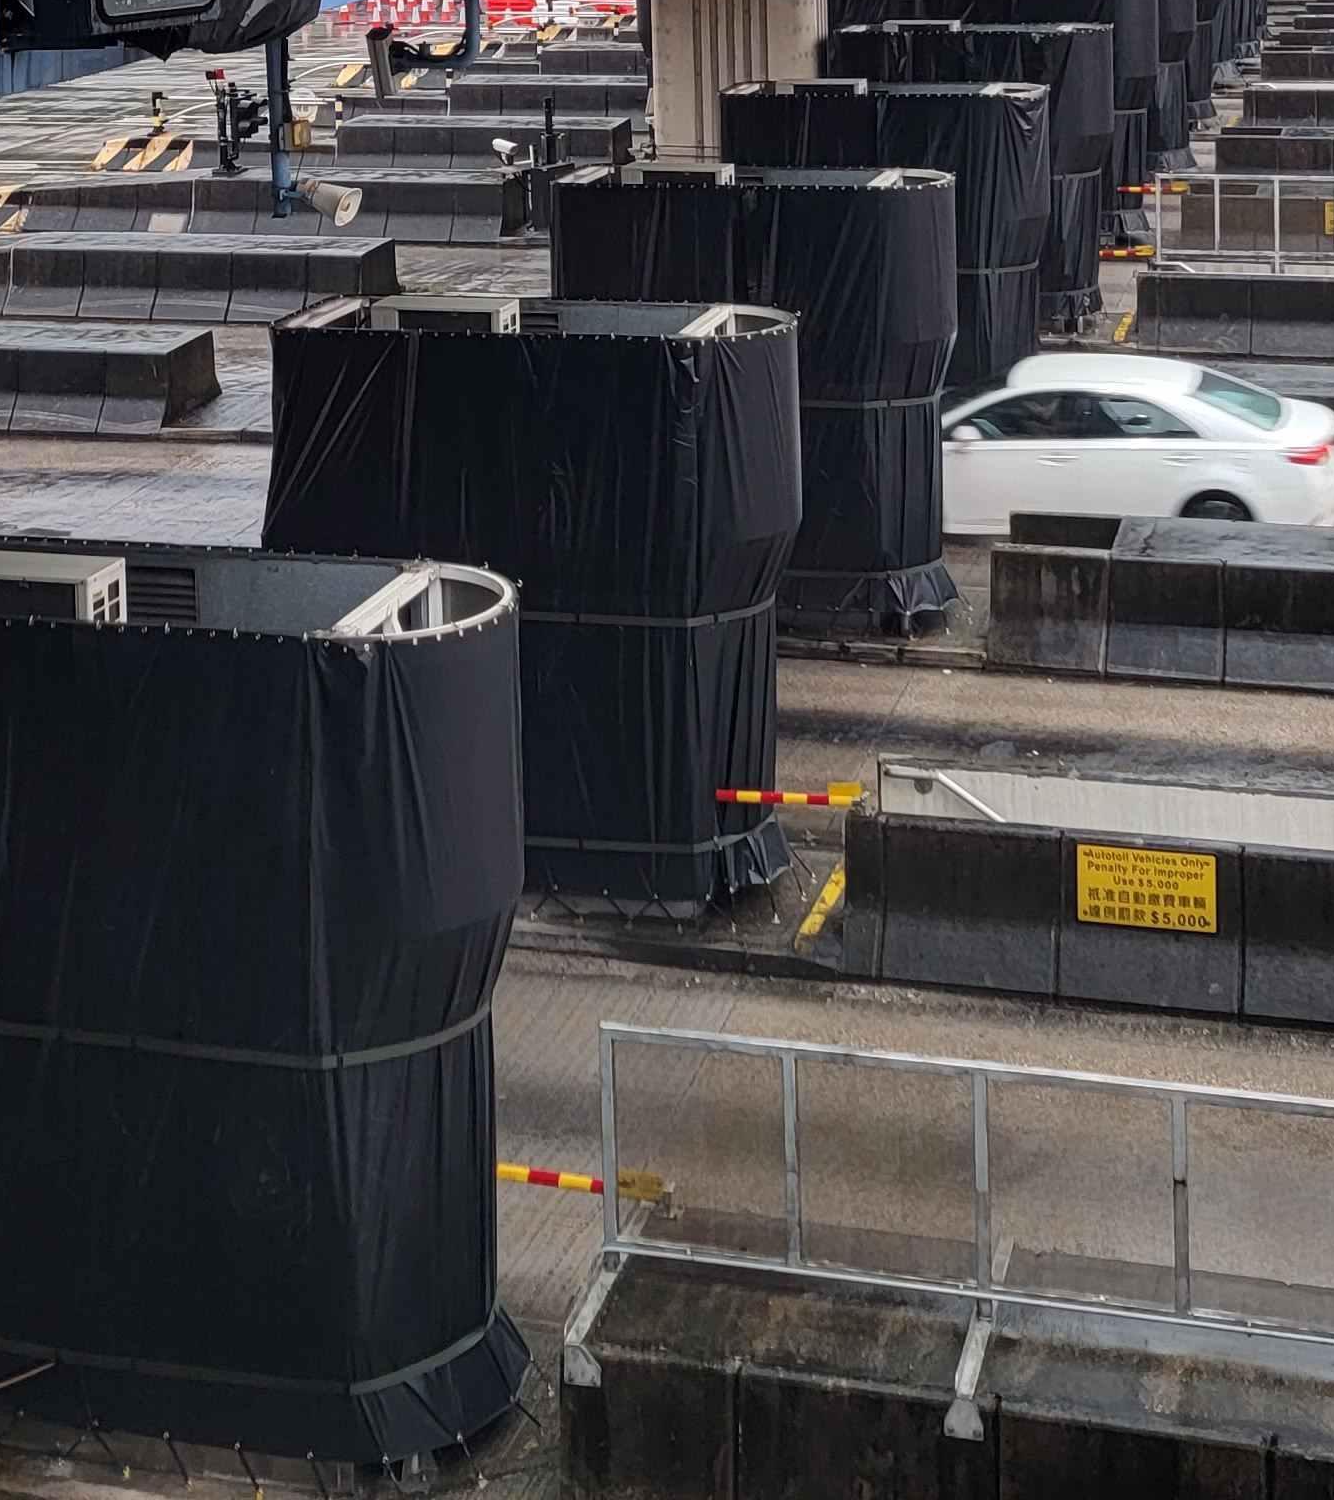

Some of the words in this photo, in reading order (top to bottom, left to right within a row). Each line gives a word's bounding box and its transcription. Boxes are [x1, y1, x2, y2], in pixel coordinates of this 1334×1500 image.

[1087, 849, 1129, 861] Autotoll
[1132, 852, 1177, 866] Vehicles
[1180, 856, 1205, 870] Only
[1087, 860, 1128, 876] Penalty
[1132, 864, 1151, 875] For
[1154, 867, 1205, 881] Improper
[1113, 875, 1134, 886] Use
